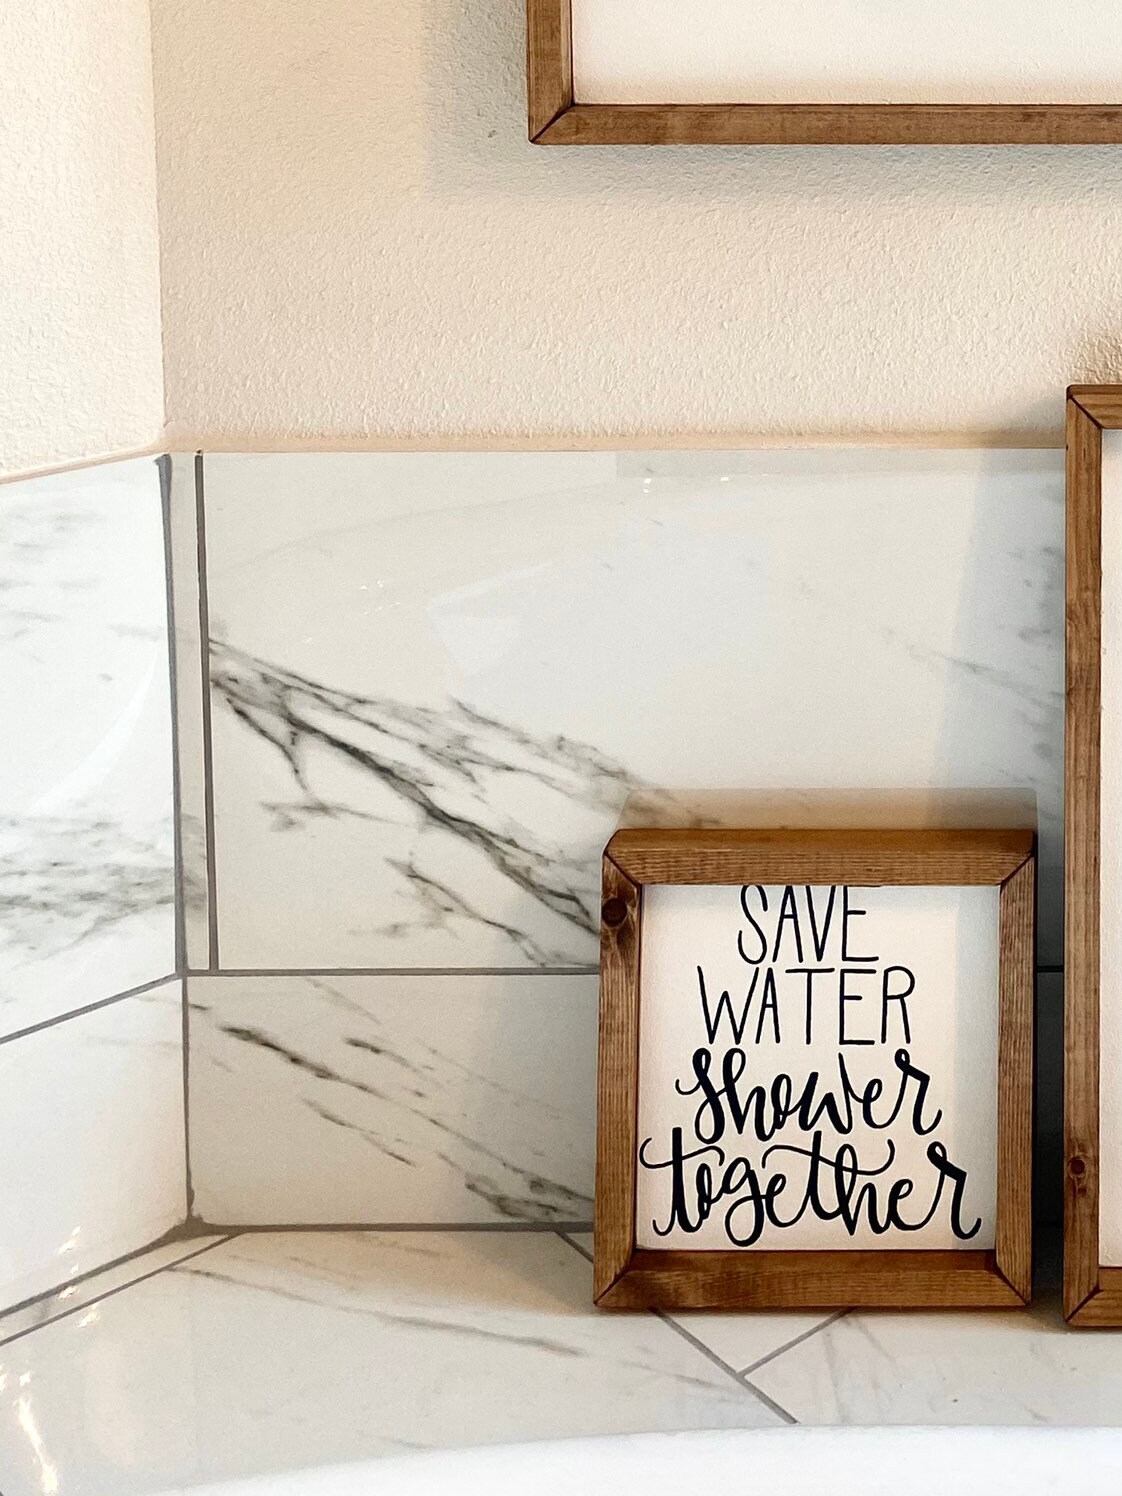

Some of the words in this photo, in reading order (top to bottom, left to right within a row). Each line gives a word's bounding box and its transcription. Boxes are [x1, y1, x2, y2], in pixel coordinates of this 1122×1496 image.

[737, 885, 883, 965] SAVE
[696, 965, 916, 1046] WATER
[674, 1047, 943, 1145] shower
[639, 1126, 983, 1248] together
